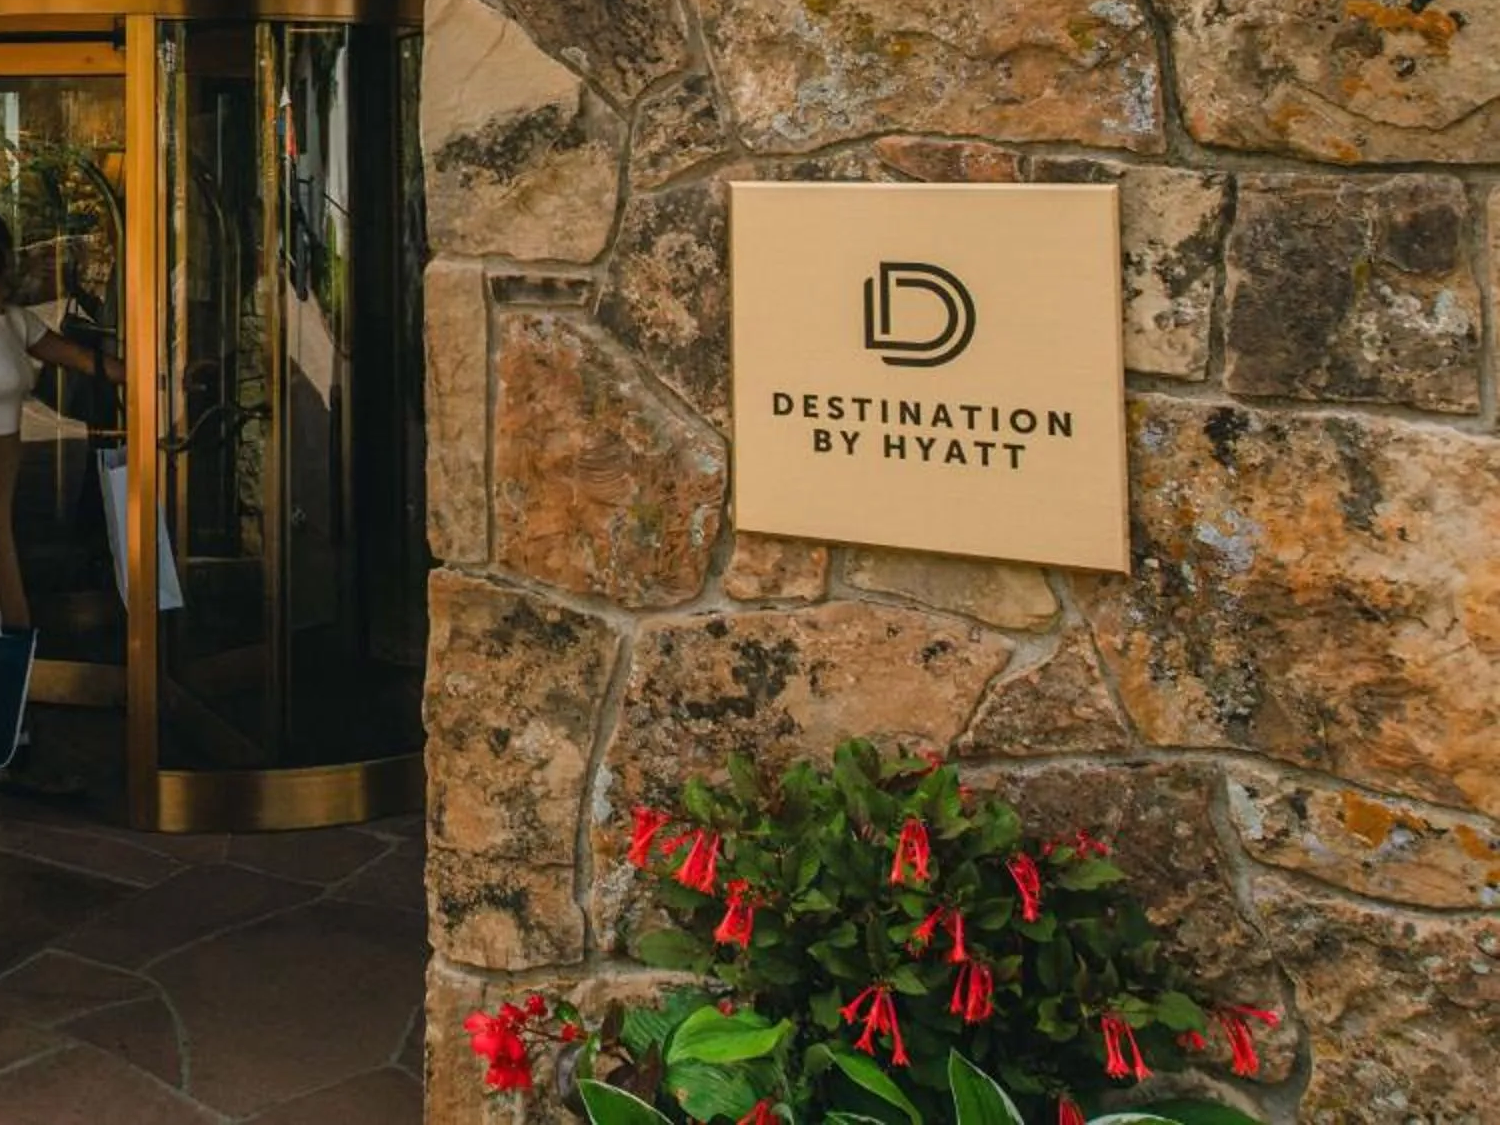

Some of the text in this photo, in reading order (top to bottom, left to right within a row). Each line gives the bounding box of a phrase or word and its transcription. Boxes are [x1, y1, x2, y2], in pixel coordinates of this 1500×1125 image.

[772, 392, 1073, 437] DESTINATION
[813, 429, 1026, 469] BY HYATT
